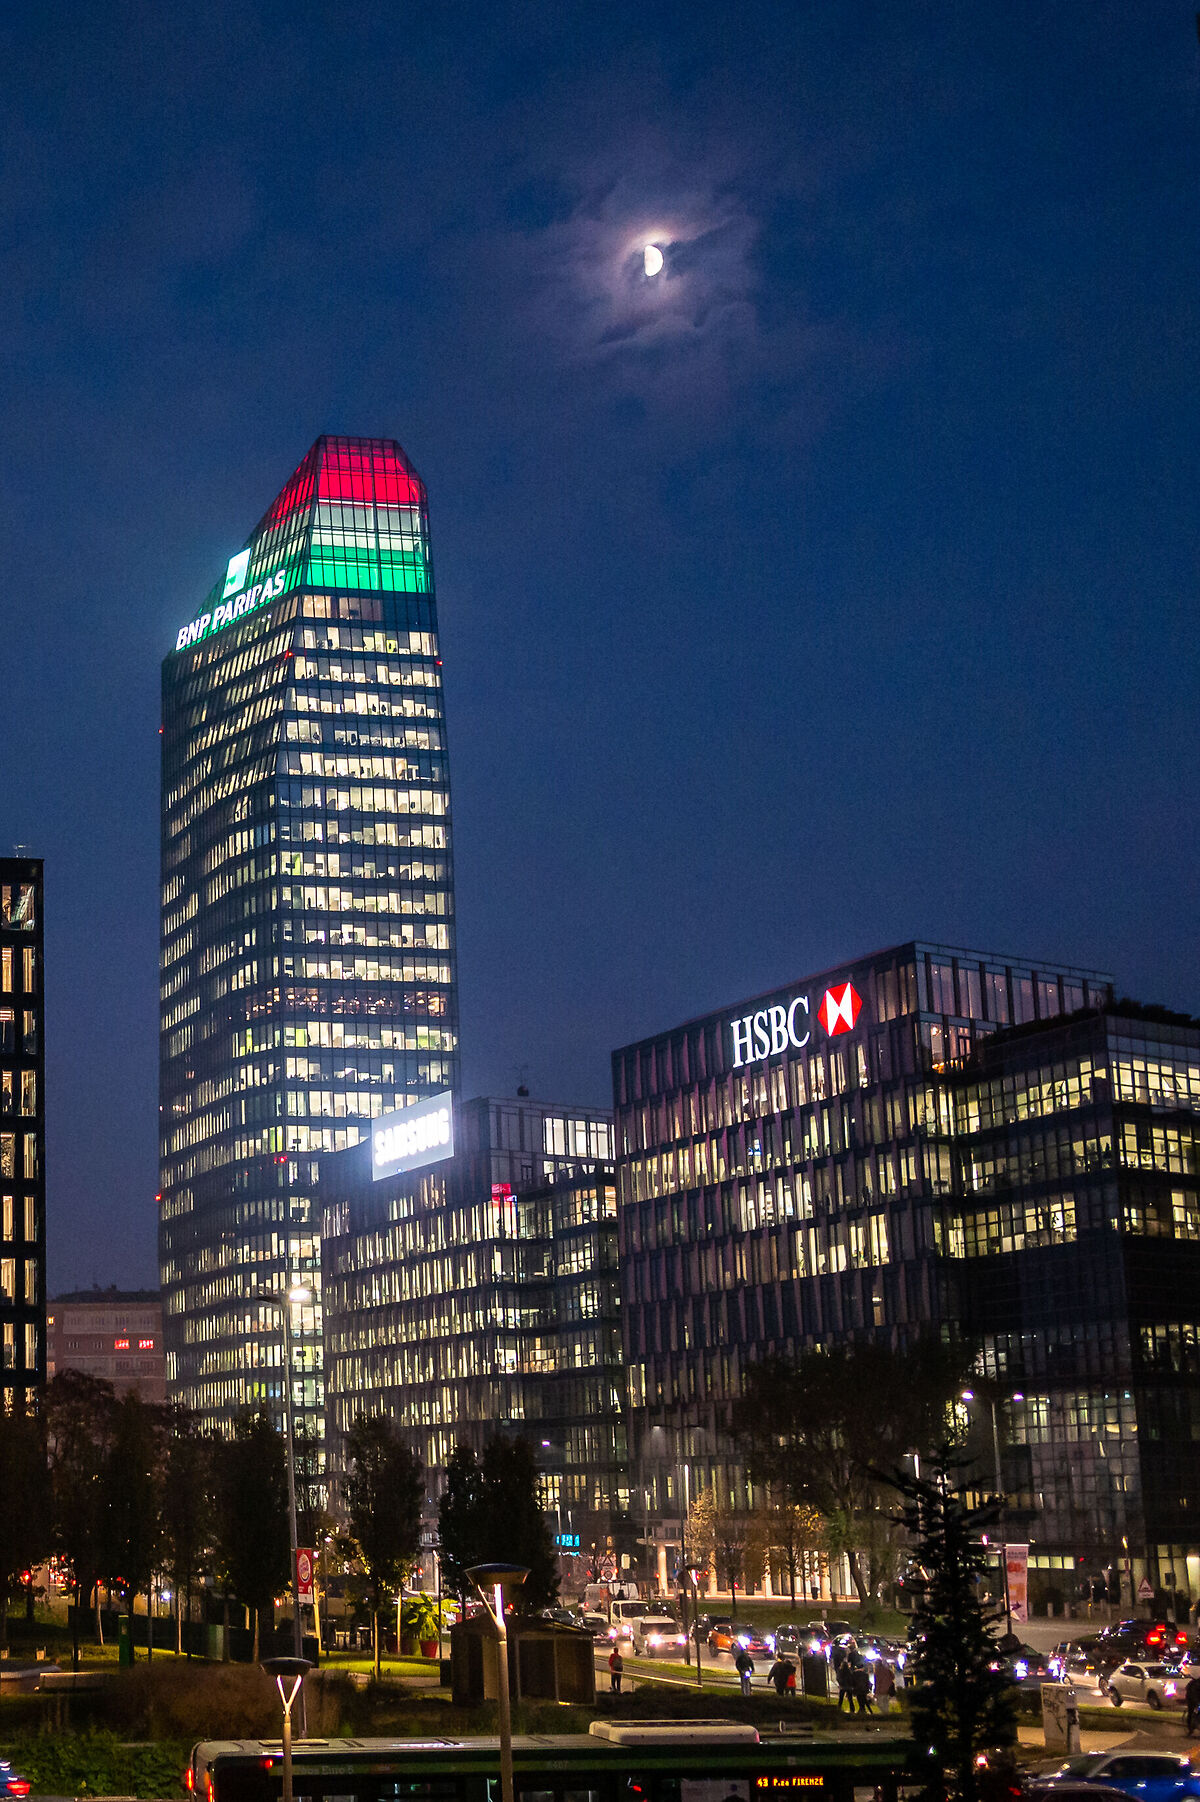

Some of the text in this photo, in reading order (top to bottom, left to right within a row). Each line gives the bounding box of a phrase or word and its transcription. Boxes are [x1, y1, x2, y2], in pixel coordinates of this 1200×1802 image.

[176, 569, 286, 650] BNP PARIBAS
[730, 996, 810, 1068] HSBC
[375, 1108, 450, 1166] SAMSUNG
[757, 1778, 769, 1787] 43
[792, 1777, 824, 1786] FIRENZE
